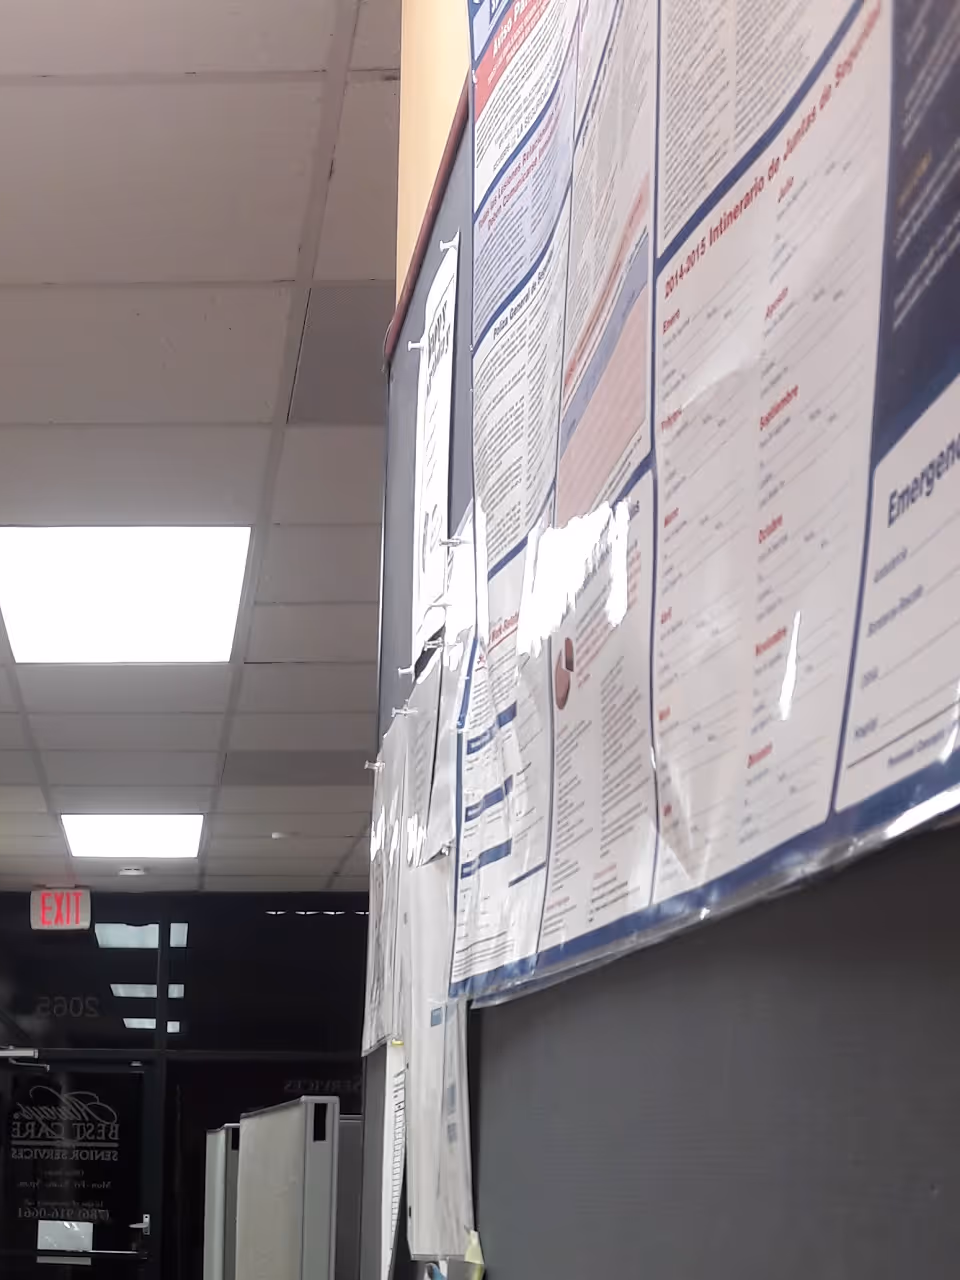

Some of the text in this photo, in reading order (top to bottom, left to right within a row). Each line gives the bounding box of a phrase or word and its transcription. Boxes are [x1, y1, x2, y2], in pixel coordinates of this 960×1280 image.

[665, 236, 706, 299] 2014-2015
[709, 175, 765, 248] Intinerario
[768, 156, 780, 181] de
[784, 105, 817, 162] Juntas
[662, 307, 680, 336] Enero
[41, 891, 83, 926] EXIT
